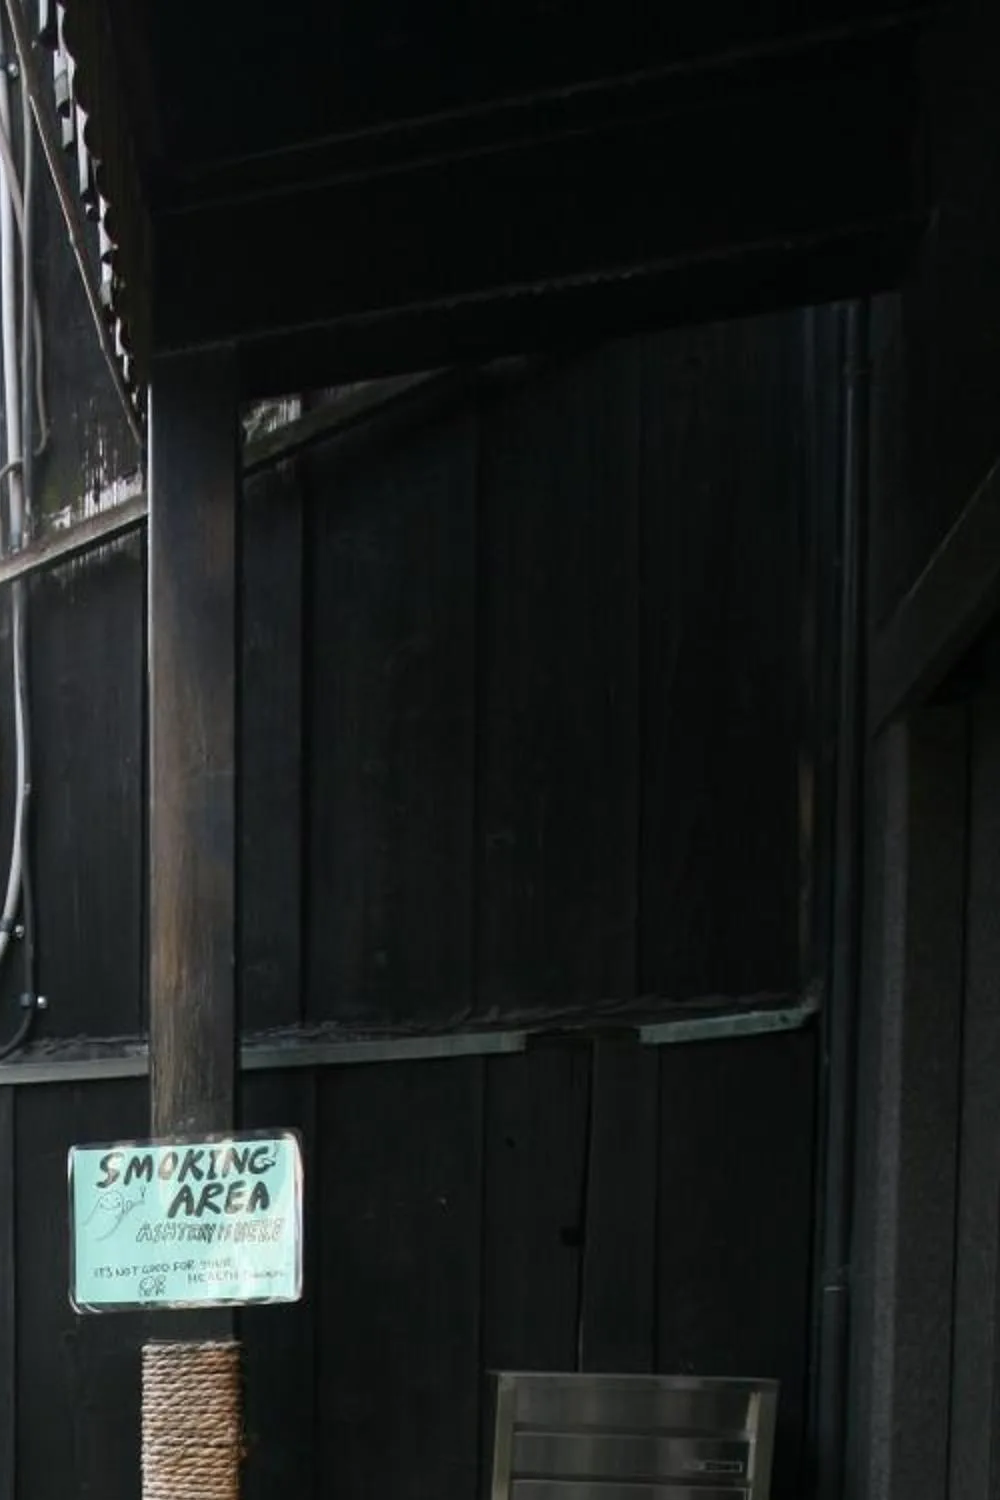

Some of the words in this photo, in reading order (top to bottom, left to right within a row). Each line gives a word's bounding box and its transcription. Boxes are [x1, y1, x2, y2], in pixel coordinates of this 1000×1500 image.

[96, 1146, 275, 1188] SMOKING
[168, 1181, 270, 1218] AREA
[135, 1221, 217, 1243] ASHTRAY
[115, 1264, 137, 1278] NOT
[141, 1262, 171, 1275] GOOD
[173, 1259, 196, 1272] FOR
